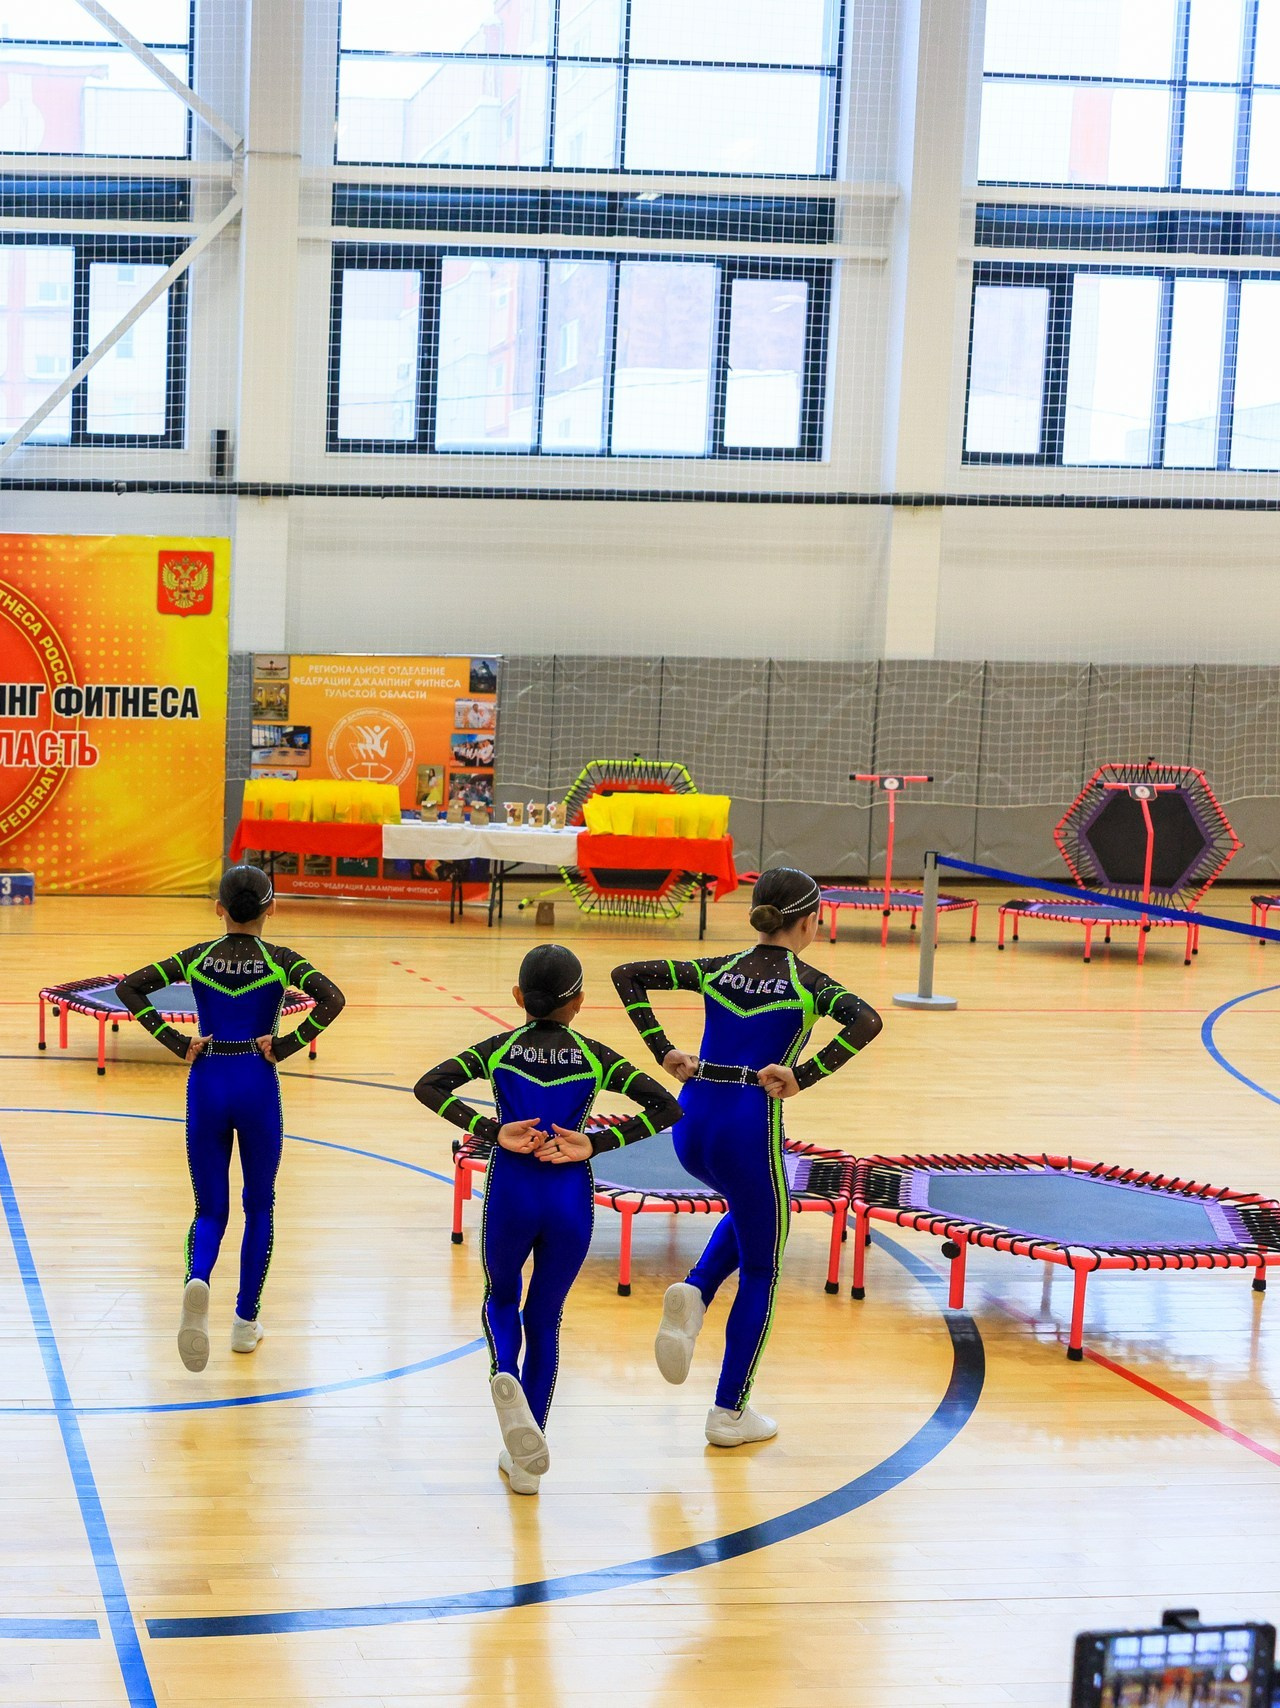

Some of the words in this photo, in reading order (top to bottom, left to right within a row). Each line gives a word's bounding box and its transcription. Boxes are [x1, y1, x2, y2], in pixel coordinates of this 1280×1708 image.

[38, 635, 69, 685] РОСС
[309, 665, 385, 675] РЕГИОНАЛЬНОЕ
[388, 666, 445, 676] ОТДЕЛЕНИЕ
[293, 677, 351, 686] ФЕДЕРАЦИИ
[353, 678, 411, 687] ДЖАМПИНГ
[415, 679, 461, 688] ФИТНЕСА
[53, 683, 201, 720] ФИТНЕСА
[325, 688, 377, 698] ТУЛЬСКОЙ
[379, 690, 427, 699] ОБЛАСТИ
[1, 877, 12, 895] 3
[202, 956, 264, 975] POLICE
[719, 972, 788, 995] POLICE
[510, 1044, 582, 1065] POLICE
